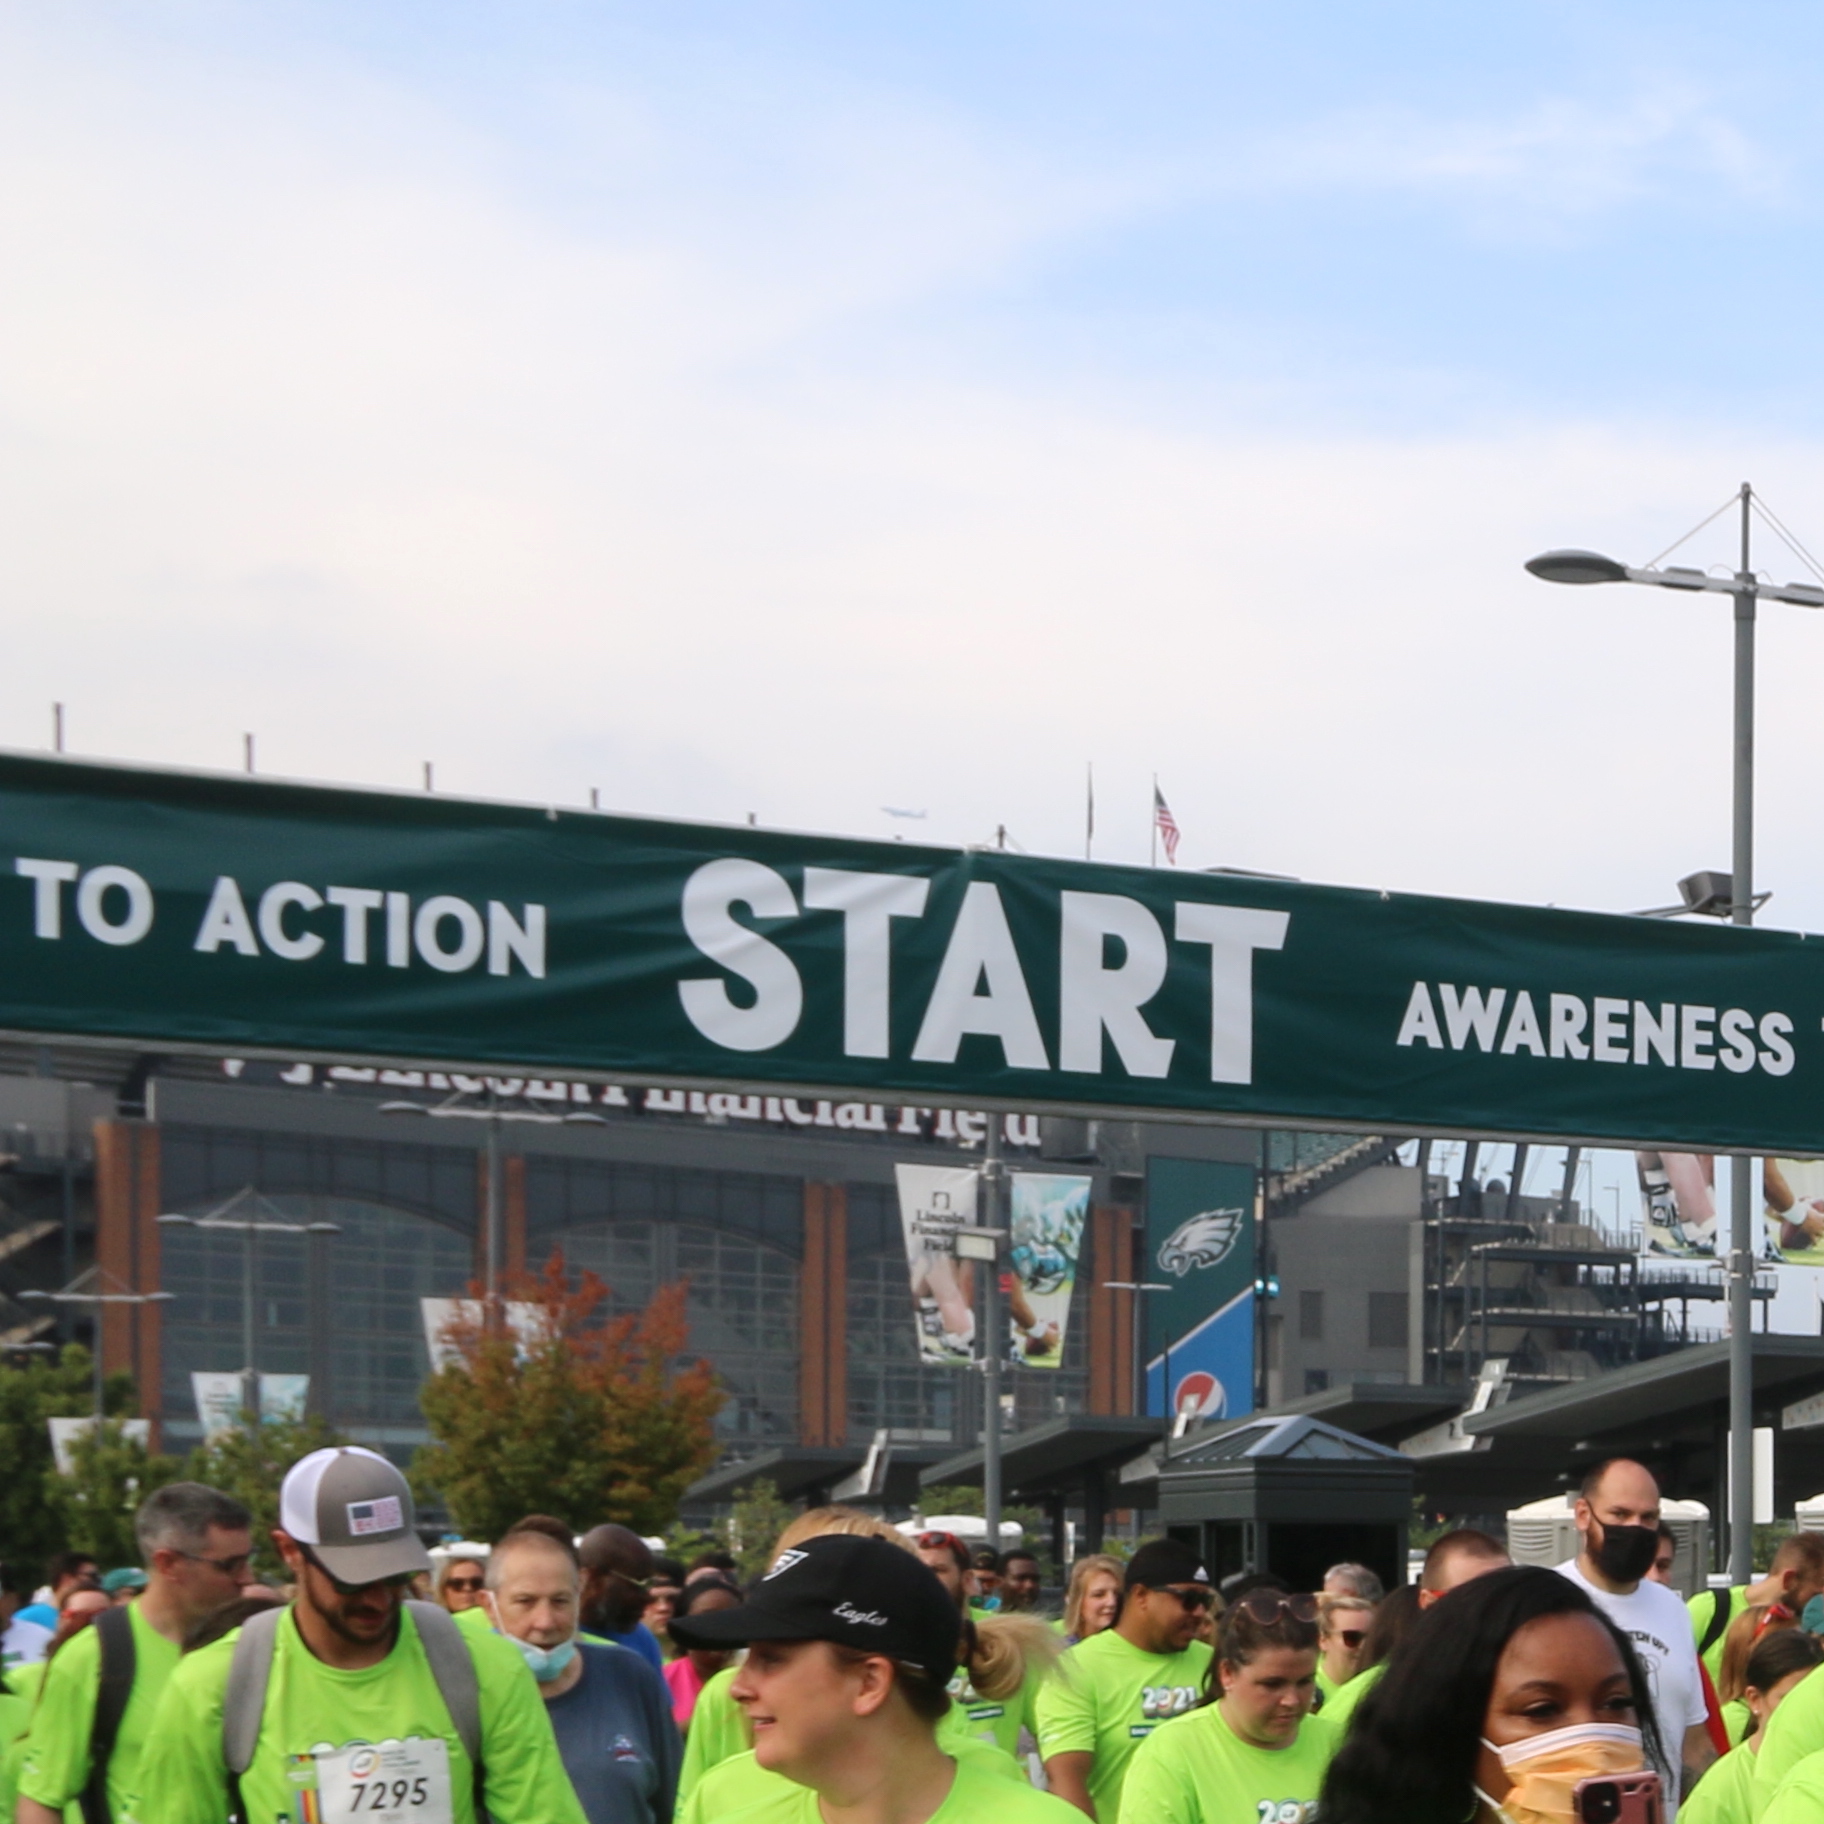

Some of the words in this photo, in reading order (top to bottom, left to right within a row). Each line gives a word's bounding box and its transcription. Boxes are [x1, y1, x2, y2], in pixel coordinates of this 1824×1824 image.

[15, 857, 154, 946] TO
[194, 876, 546, 979] ACTION
[677, 857, 1291, 1085] START
[1396, 980, 1796, 1077] AWARENESS
[832, 1601, 888, 1626] Eagles
[349, 1777, 429, 1812] 7295
